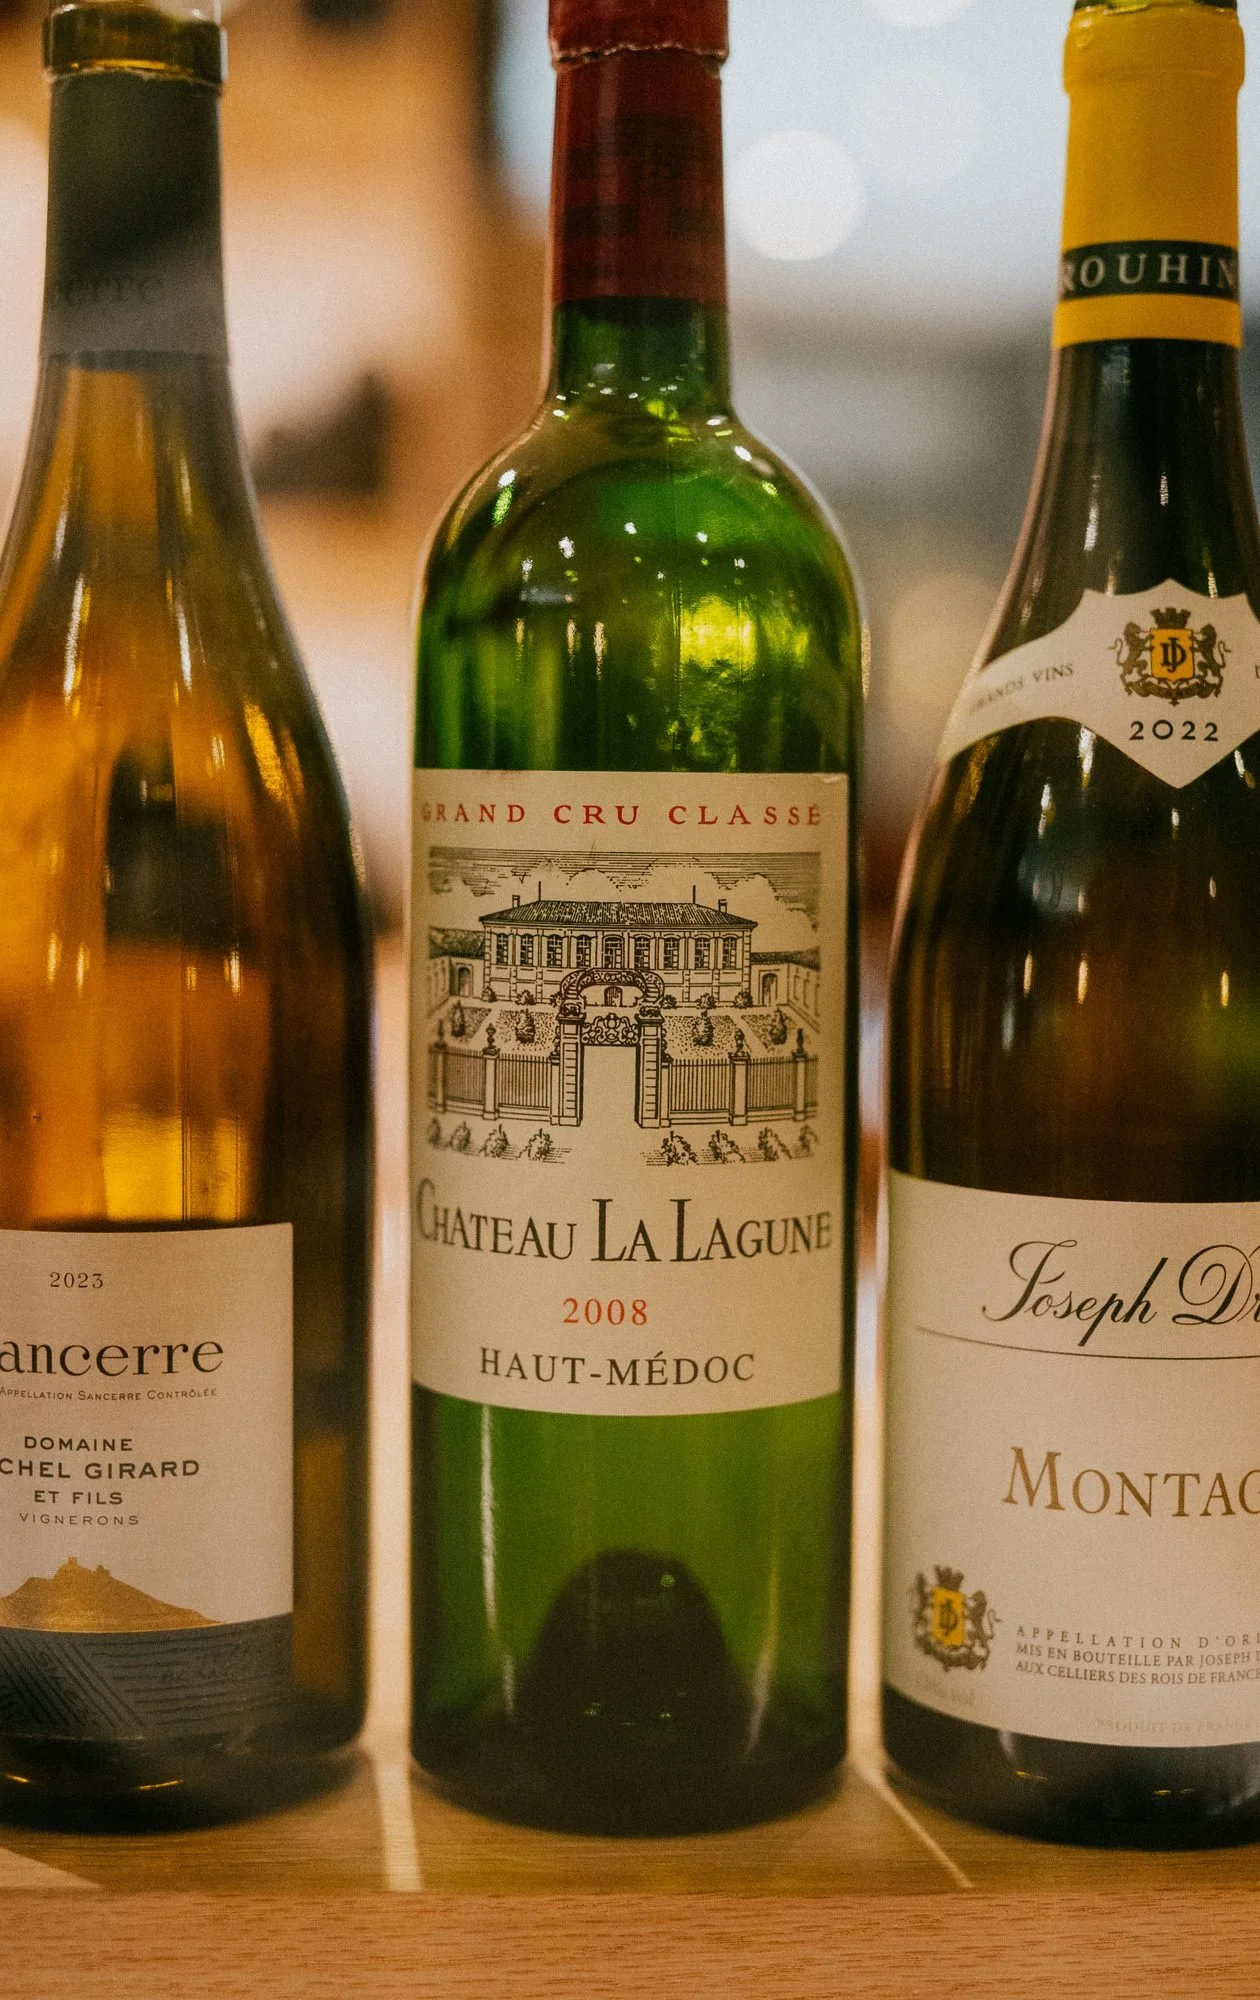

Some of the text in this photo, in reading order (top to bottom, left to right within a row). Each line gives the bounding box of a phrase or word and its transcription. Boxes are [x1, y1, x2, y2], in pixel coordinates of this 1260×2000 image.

[1033, 663, 1074, 683] VINS
[1129, 719, 1219, 742] 2022
[421, 802, 822, 826] GRAND CRU CLASSÉ
[415, 1177, 833, 1263] CHATEAU LA LAGUNE
[50, 1271, 103, 1289] 2023
[981, 1239, 1169, 1347] Joseph
[562, 1297, 648, 1326] 2008
[0, 1341, 224, 1377] ancerre
[479, 1346, 755, 1387] HAUT-MÉDOC
[0, 1387, 217, 1401] APPELLATION SANCERRE CONTRÔLÉE
[24, 1436, 133, 1451] DOMAINE
[0, 1457, 200, 1480] CHEL GIRARD
[1001, 1446, 1260, 1518] MONTAG
[34, 1490, 124, 1505] ET FILS
[19, 1512, 139, 1526] VIGNERONS
[1016, 1625, 1182, 1649] APPELLATION
[1016, 1642, 1042, 1657] MIS
[1047, 1646, 1067, 1660] EN
[1073, 1649, 1161, 1667] BOUTEILLE
[1167, 1655, 1194, 1667] PAR
[1198, 1651, 1251, 1668] JOSEPH
[1015, 1660, 1044, 1675] AUX
[1047, 1664, 1116, 1682] CELLIERS
[1119, 1671, 1146, 1684] DES
[1151, 1673, 1184, 1684] ROIS
[1187, 1672, 1206, 1684] DE
